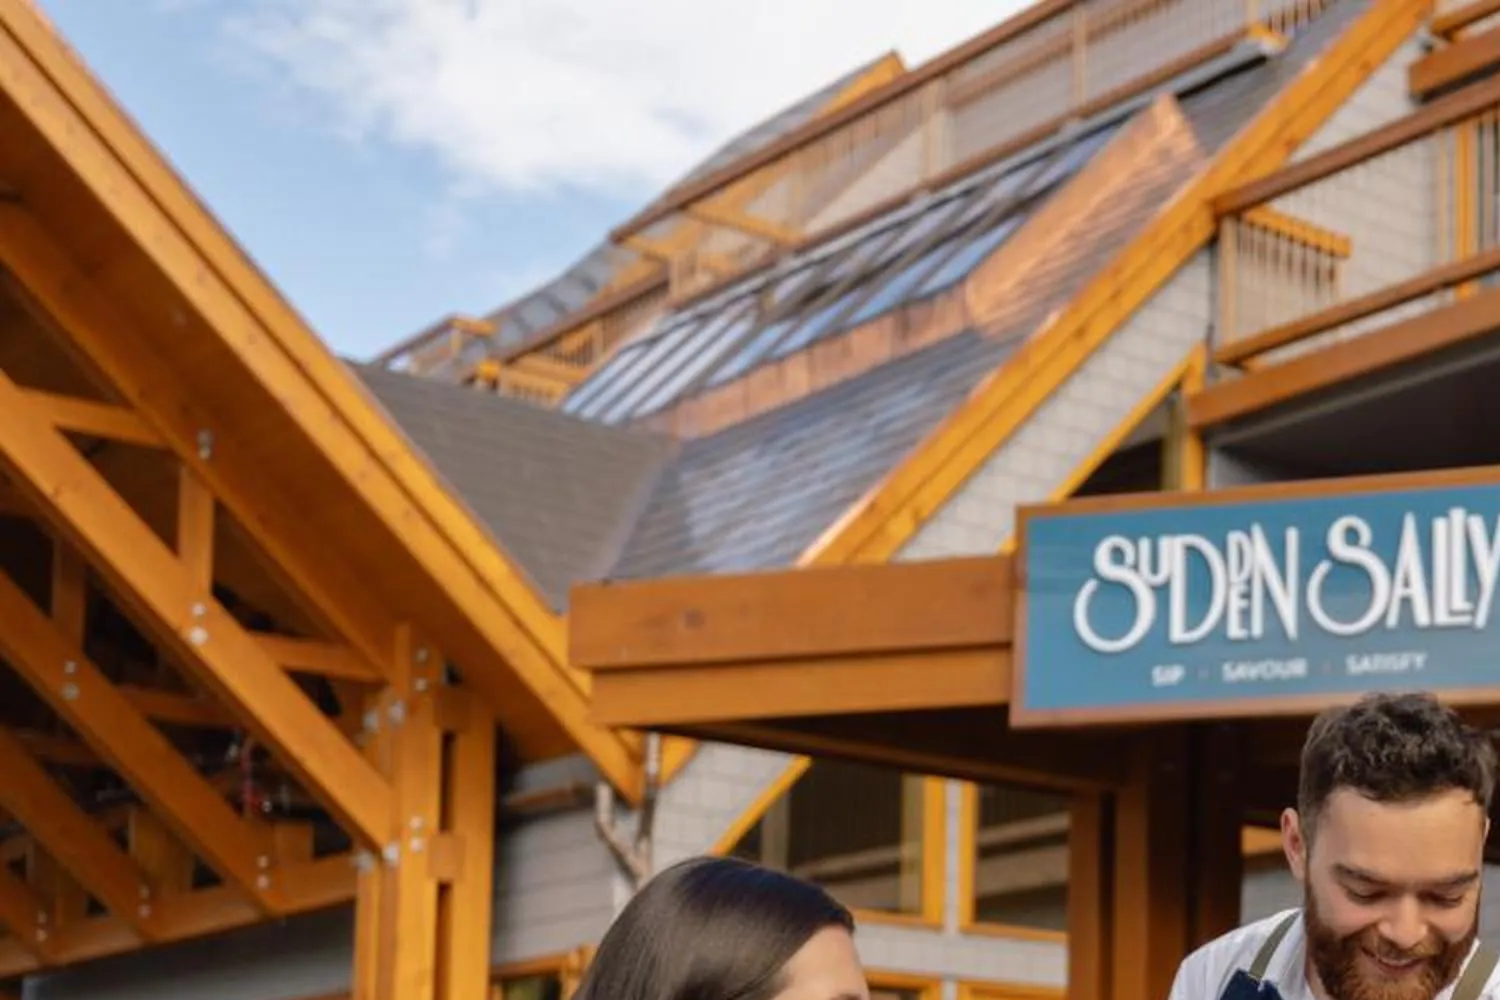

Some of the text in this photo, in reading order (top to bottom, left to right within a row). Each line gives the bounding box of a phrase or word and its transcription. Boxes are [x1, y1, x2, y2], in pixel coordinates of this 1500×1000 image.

[1151, 652, 1428, 687] SIP SAVOUR SATISFY
